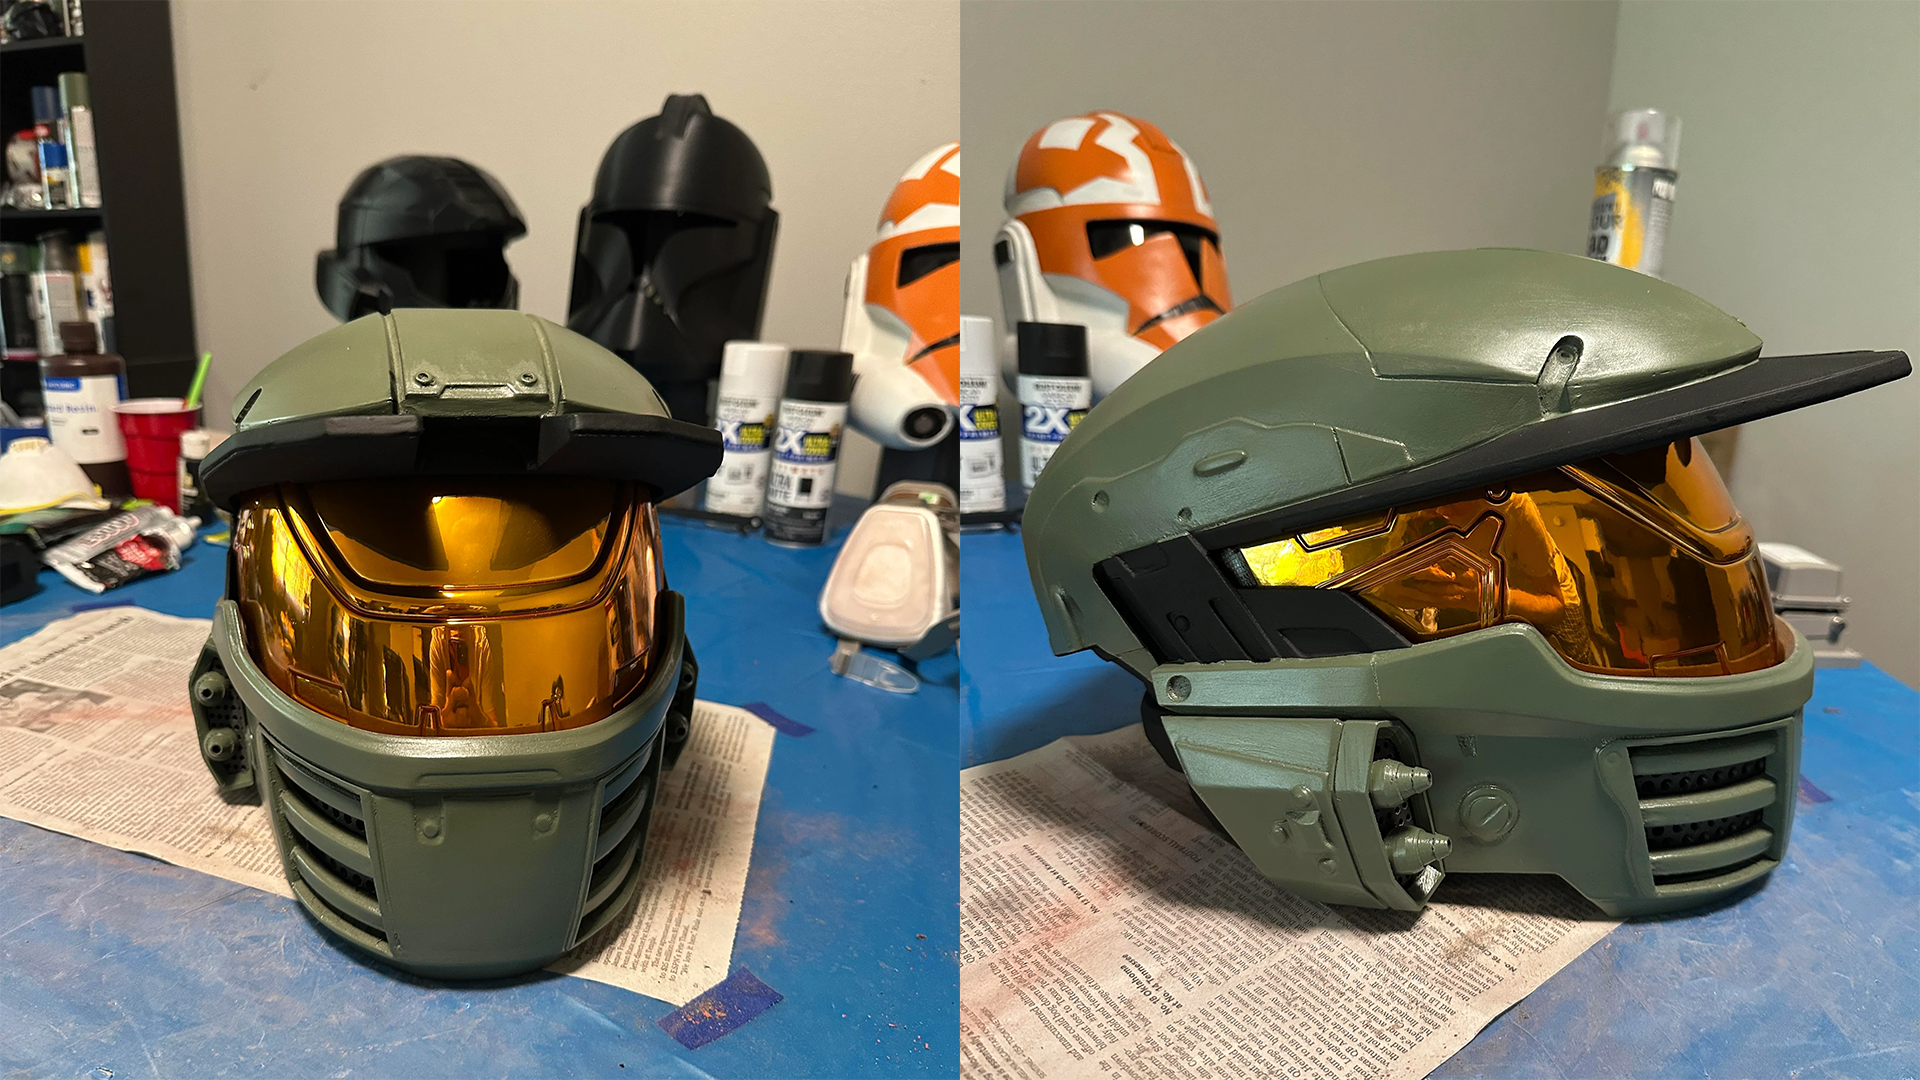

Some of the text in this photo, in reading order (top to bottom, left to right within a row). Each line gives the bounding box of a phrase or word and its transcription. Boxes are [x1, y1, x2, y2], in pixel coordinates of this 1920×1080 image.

[1023, 405, 1072, 434] 2X
[775, 428, 804, 454] 2X
[1022, 843, 1037, 856] State
[1035, 854, 1053, 870] Kansas
[1055, 874, 1069, 886] Tech
[1067, 884, 1084, 899] Texas
[675, 942, 684, 954] Pete
[683, 951, 692, 963] love
[1313, 935, 1360, 972] strong outing
[1320, 928, 1364, 964] DB Heard
[1188, 971, 1204, 986] Why
[1202, 969, 1222, 987] effect
[1212, 952, 1240, 976] qualified
[1407, 969, 1429, 987] could
[1503, 960, 1517, 975] No.
[1119, 964, 1172, 1015] No. 18 Oklahoma
[1122, 953, 1183, 1009] at No. 14 Tennessee
[1317, 950, 1419, 1027] limited snaps. The Vanderbilt
[1345, 985, 1374, 1007] has had
[1375, 958, 1456, 1016] and LB Bryan Longwell.
[1434, 987, 1453, 1004] Why
[1032, 989, 1095, 1056] offense could bog down
[1047, 987, 1107, 1050] blowout loss to Texas
[1077, 984, 1129, 1038] unfold and viewers
[1098, 989, 1141, 1032] take advantage
[1227, 988, 1310, 1057] to his credit on the season.
[1235, 982, 1344, 1071] sure to receive added attention
[1253, 985, 1351, 1064] Longhorns LB Anthony Hill
[1263, 967, 1390, 1067] ventures outside the pocket have taken
[1270, 962, 1399, 1061] their toll he concussion protocol
[1292, 1002, 1329, 1033] Manning's
[1337, 1002, 1360, 1021] listed
[1354, 1001, 1387, 1028] available,
[1030, 1006, 1084, 1062] and unaccustomed
[1166, 1024, 1216, 1067] alive. an
[1187, 1012, 1264, 1079] but could use road vic-
[1197, 1006, 1266, 1065] Playoff position. Com-
[1206, 999, 1301, 1078] QB Diego Pavia continues to
[1214, 993, 1311, 1072] Heisman with 20 total
[1327, 1031, 1347, 1047] Arch
[1359, 1018, 1391, 1043] officially
[1155, 1030, 1197, 1067] College Foot-
[1184, 1024, 1246, 1078] more, has couple
[1345, 1045, 1358, 1057] QB
[1390, 1041, 1408, 1055] and
[1358, 1055, 1381, 1075] Texas
